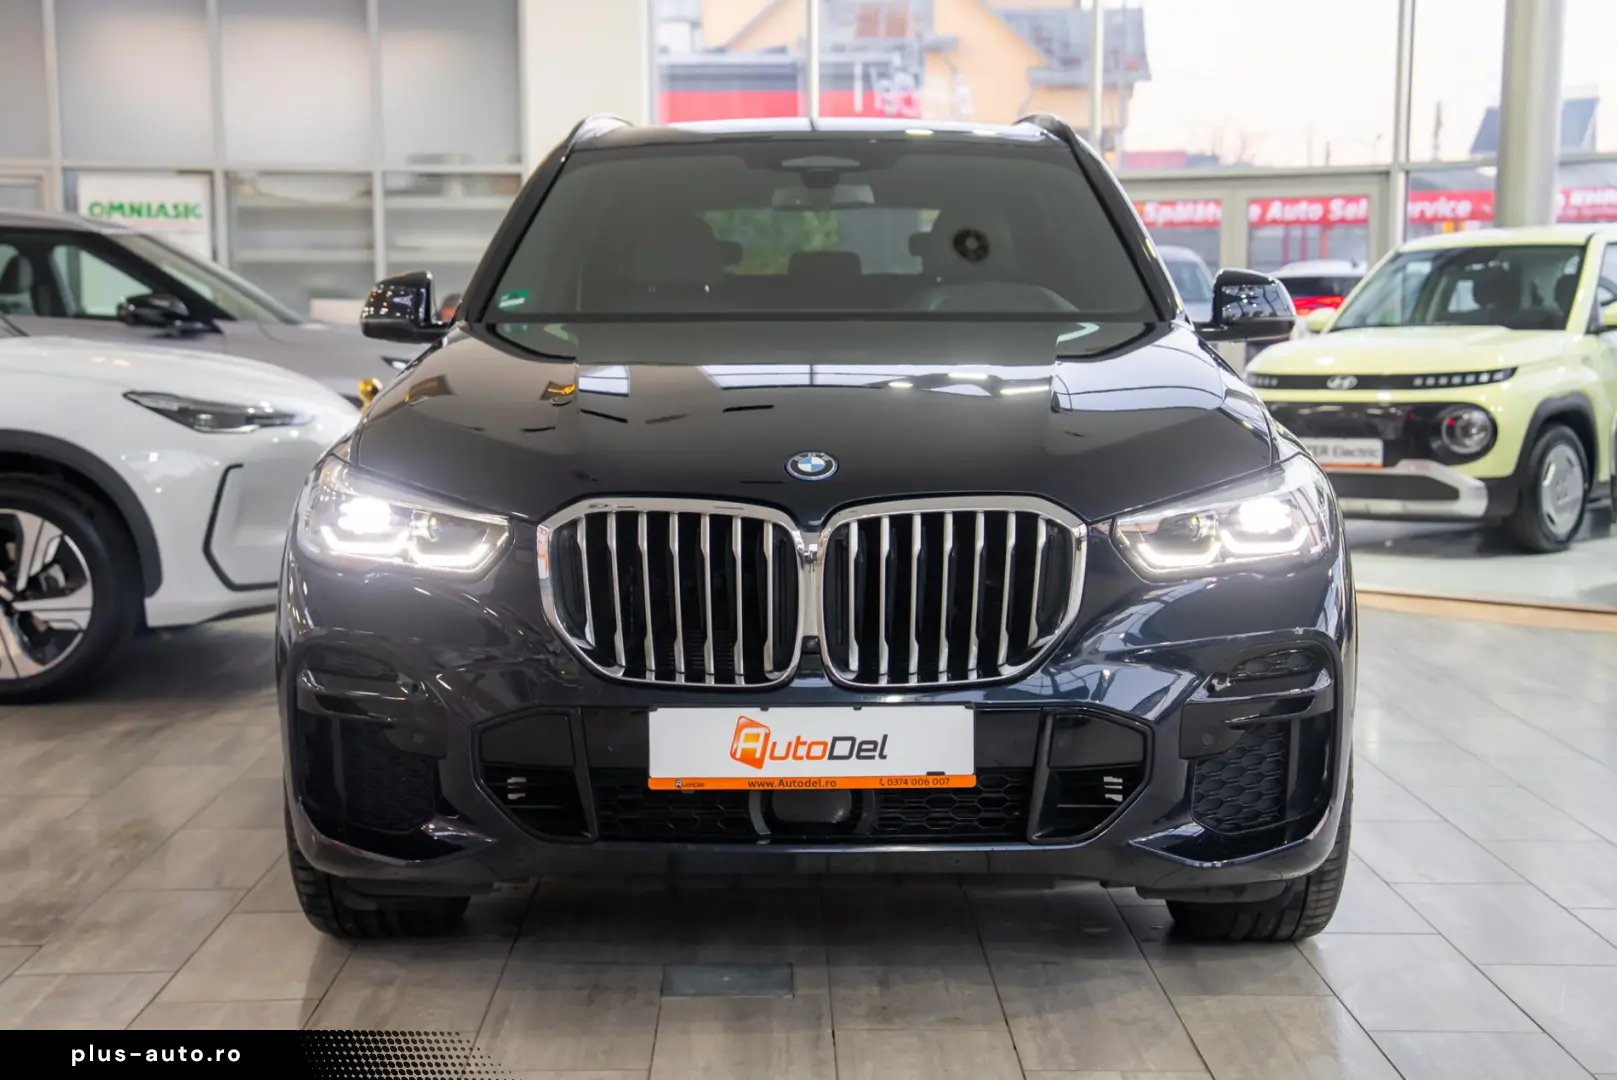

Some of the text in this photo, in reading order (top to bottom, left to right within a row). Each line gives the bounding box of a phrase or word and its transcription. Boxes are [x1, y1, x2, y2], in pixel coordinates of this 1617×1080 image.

[1266, 200, 1324, 222] Auto
[730, 715, 889, 770] AutoDel
[747, 779, 837, 788] www.Autodel.ro
[887, 777, 950, 786] 0374 006 007
